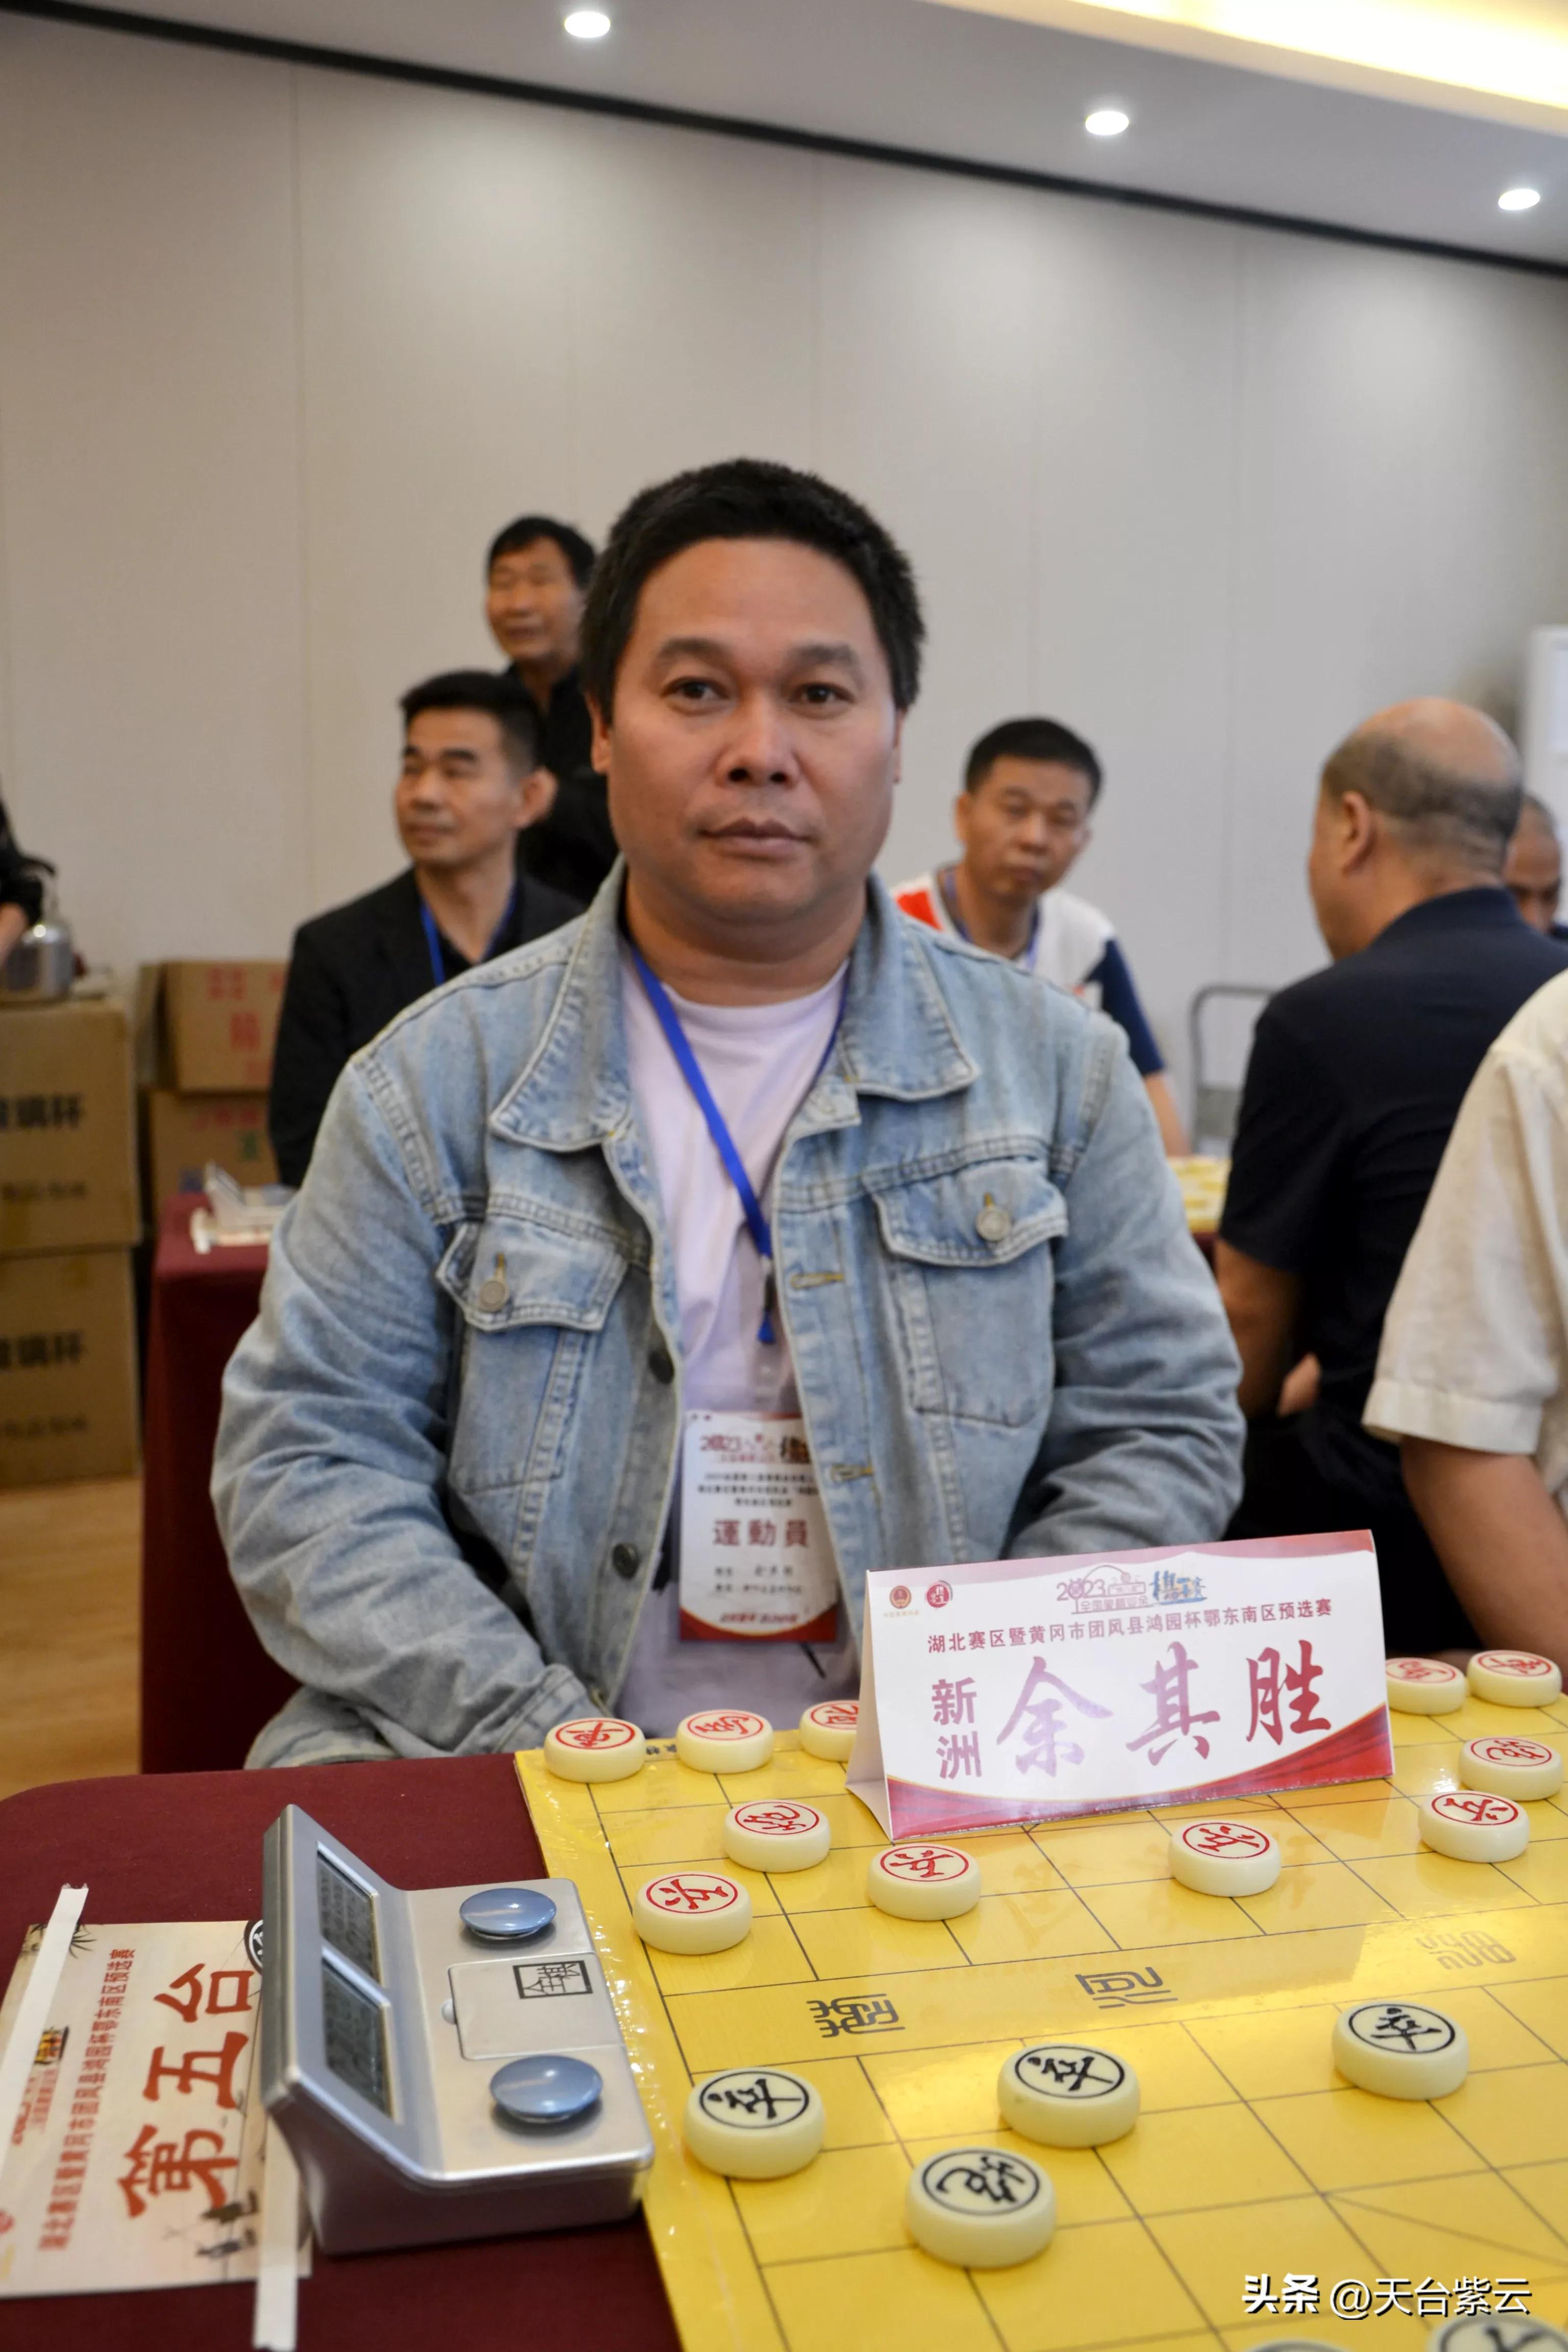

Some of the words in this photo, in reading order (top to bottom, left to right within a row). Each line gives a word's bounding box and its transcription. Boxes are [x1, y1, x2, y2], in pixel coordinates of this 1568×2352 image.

[713, 1519, 809, 1548] 運動員
[927, 1598, 1334, 1655] 湖北赛区暨黄冈市团风县鸿园杯鄂东南区预选赛
[930, 1676, 982, 1780] 新洲
[996, 1639, 1333, 1778] 余其胜
[889, 1849, 954, 1878] 兵
[658, 1878, 729, 1910] 兵
[117, 1962, 255, 2219] 第五台
